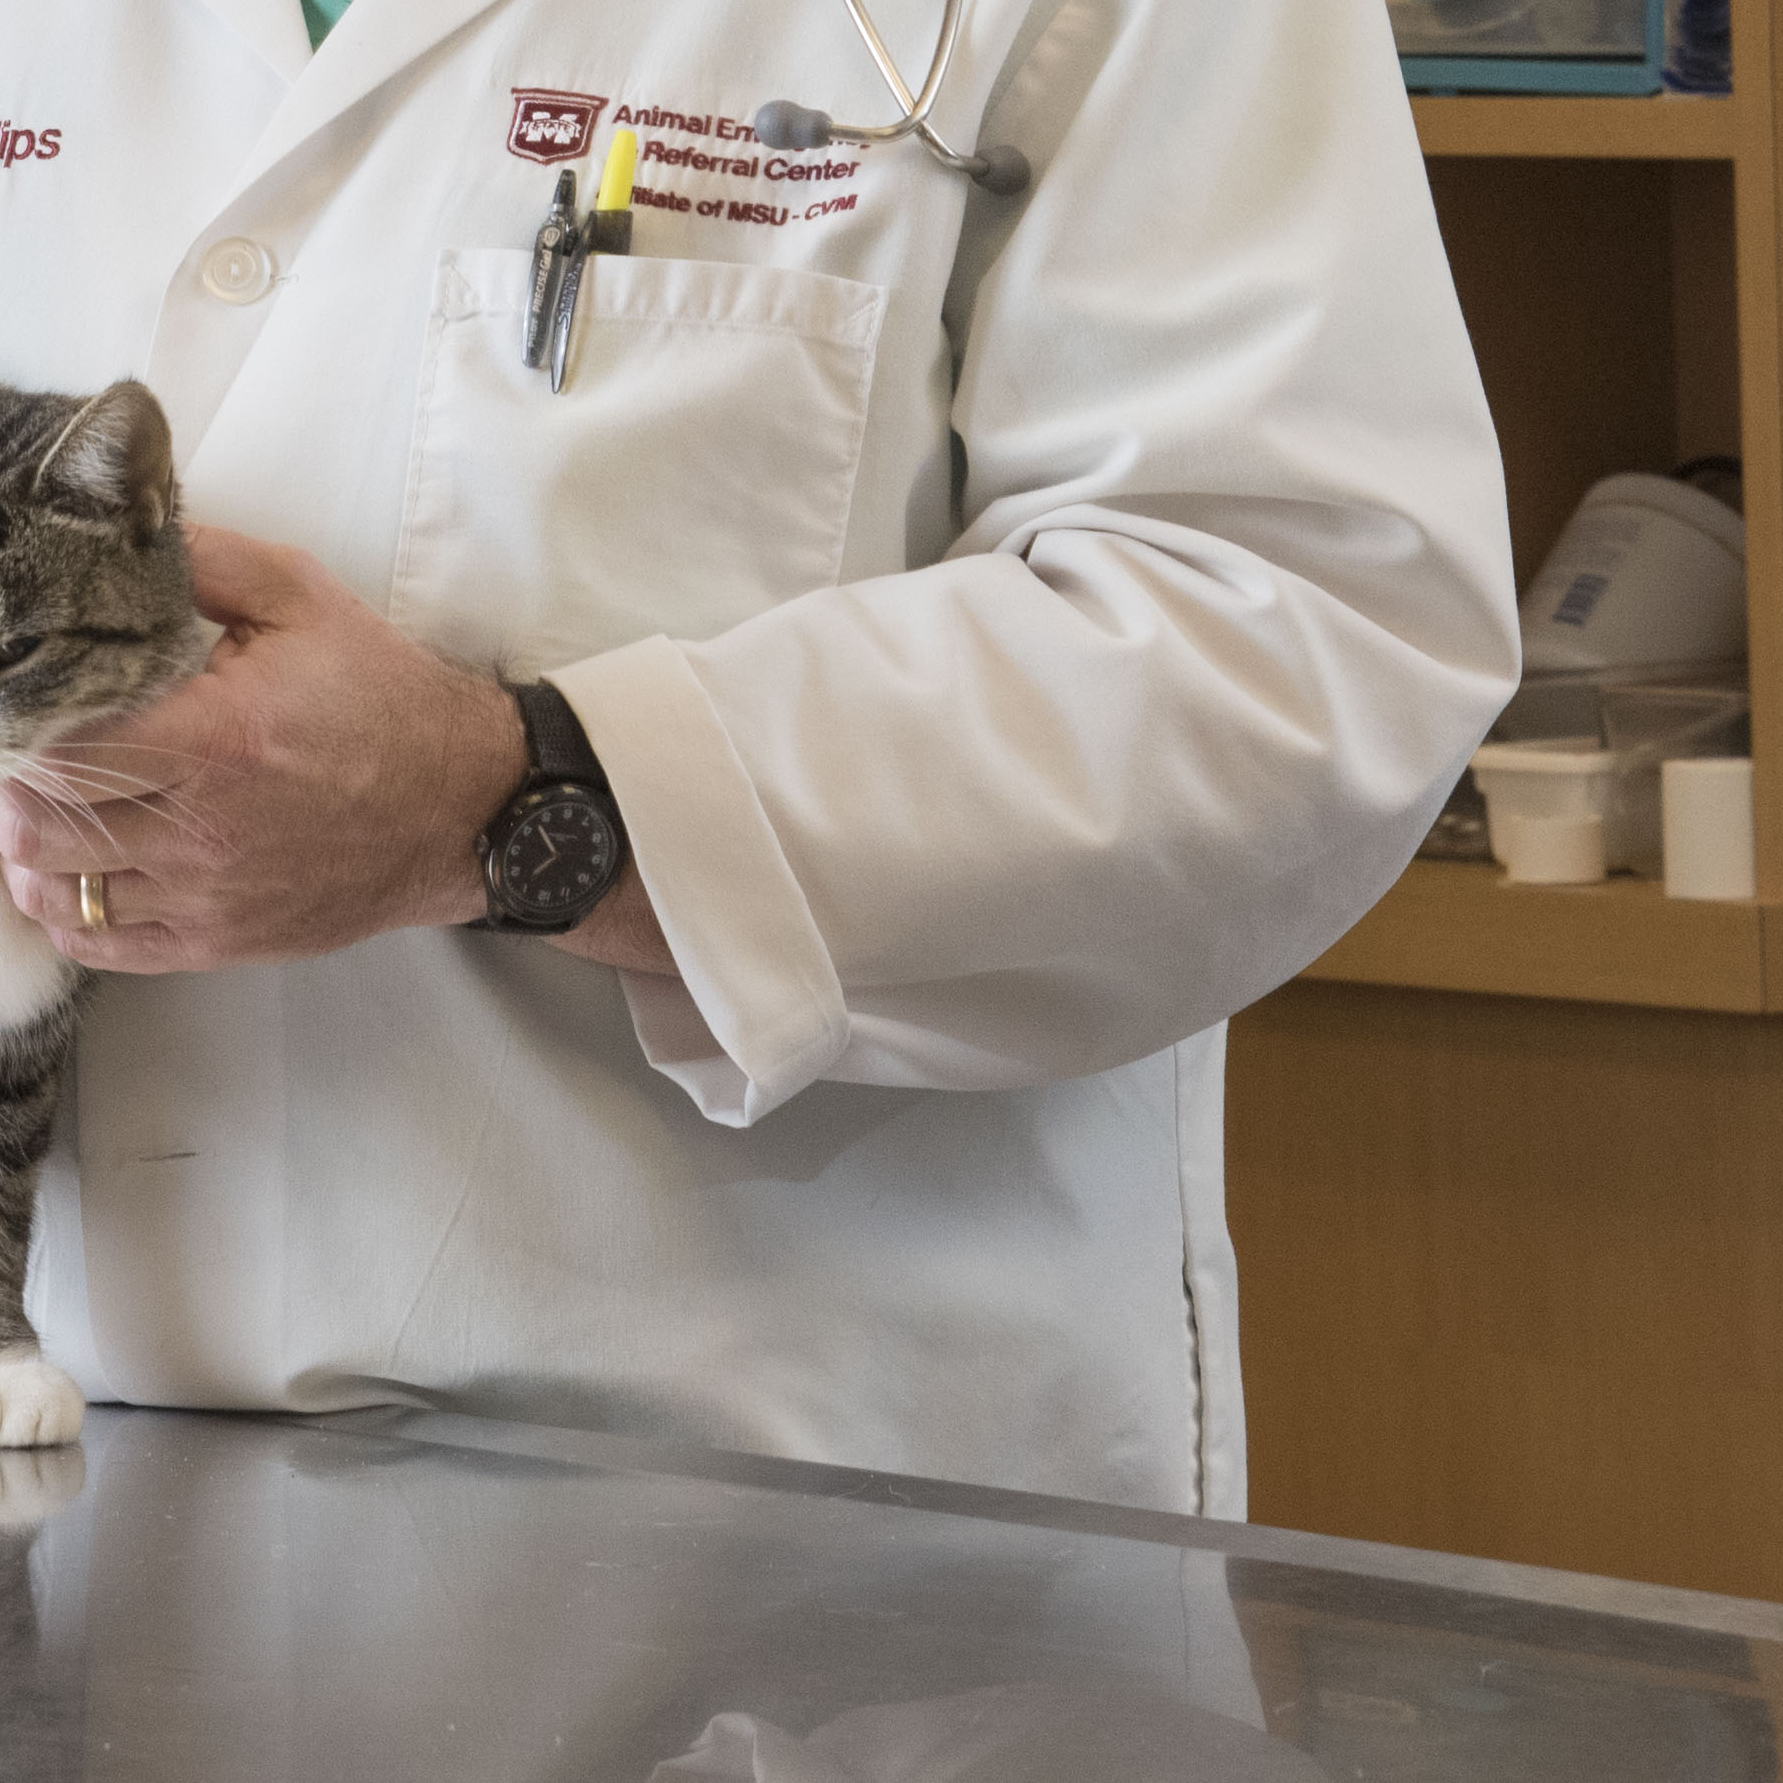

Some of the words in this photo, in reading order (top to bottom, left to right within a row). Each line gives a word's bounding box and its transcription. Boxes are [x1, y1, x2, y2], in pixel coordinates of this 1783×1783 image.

[612, 105, 713, 136] Animal
[642, 141, 759, 178] Referral
[763, 157, 860, 182] Center
[696, 199, 726, 218] of
[727, 201, 790, 227] MSU
[804, 194, 859, 221] CVM
[532, 270, 550, 313] PRECISE
